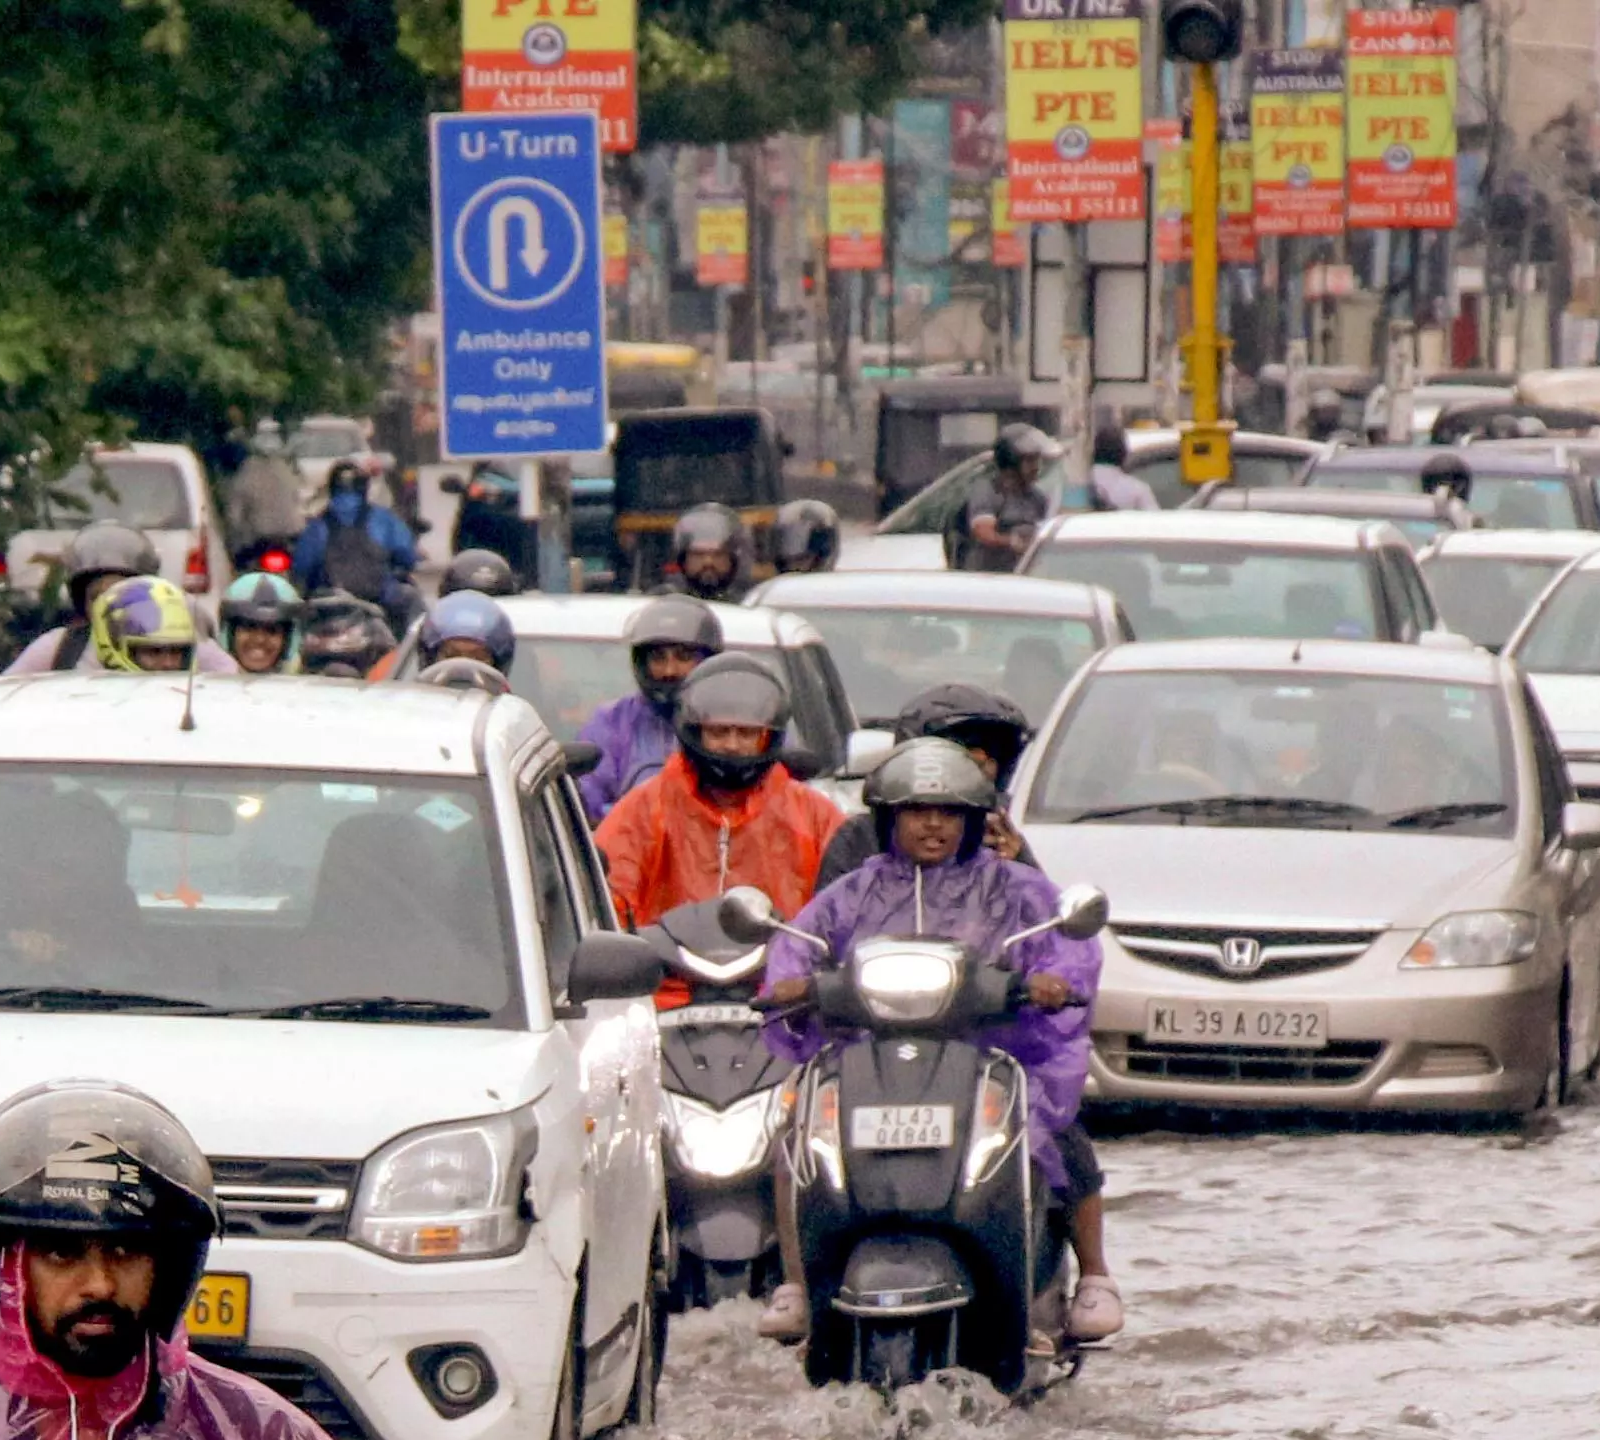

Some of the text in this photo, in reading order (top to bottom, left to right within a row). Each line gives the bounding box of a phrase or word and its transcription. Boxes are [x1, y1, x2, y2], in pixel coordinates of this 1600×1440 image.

[1011, 38, 1139, 70] IELTS
[466, 64, 627, 88] International
[1352, 71, 1447, 97] IELTS
[493, 87, 605, 109] Academy
[1033, 91, 1117, 122] PTE
[1256, 106, 1343, 127] IELTS
[1366, 115, 1431, 142] PTE
[458, 129, 579, 160] U-Turn
[1272, 141, 1328, 163] PTE
[1012, 155, 1138, 176] International
[456, 328, 592, 352] Ambulance
[493, 356, 553, 382] Only
[1153, 1007, 1320, 1038] KL 39 A 0232
[43, 1184, 87, 1199] ROYAL
